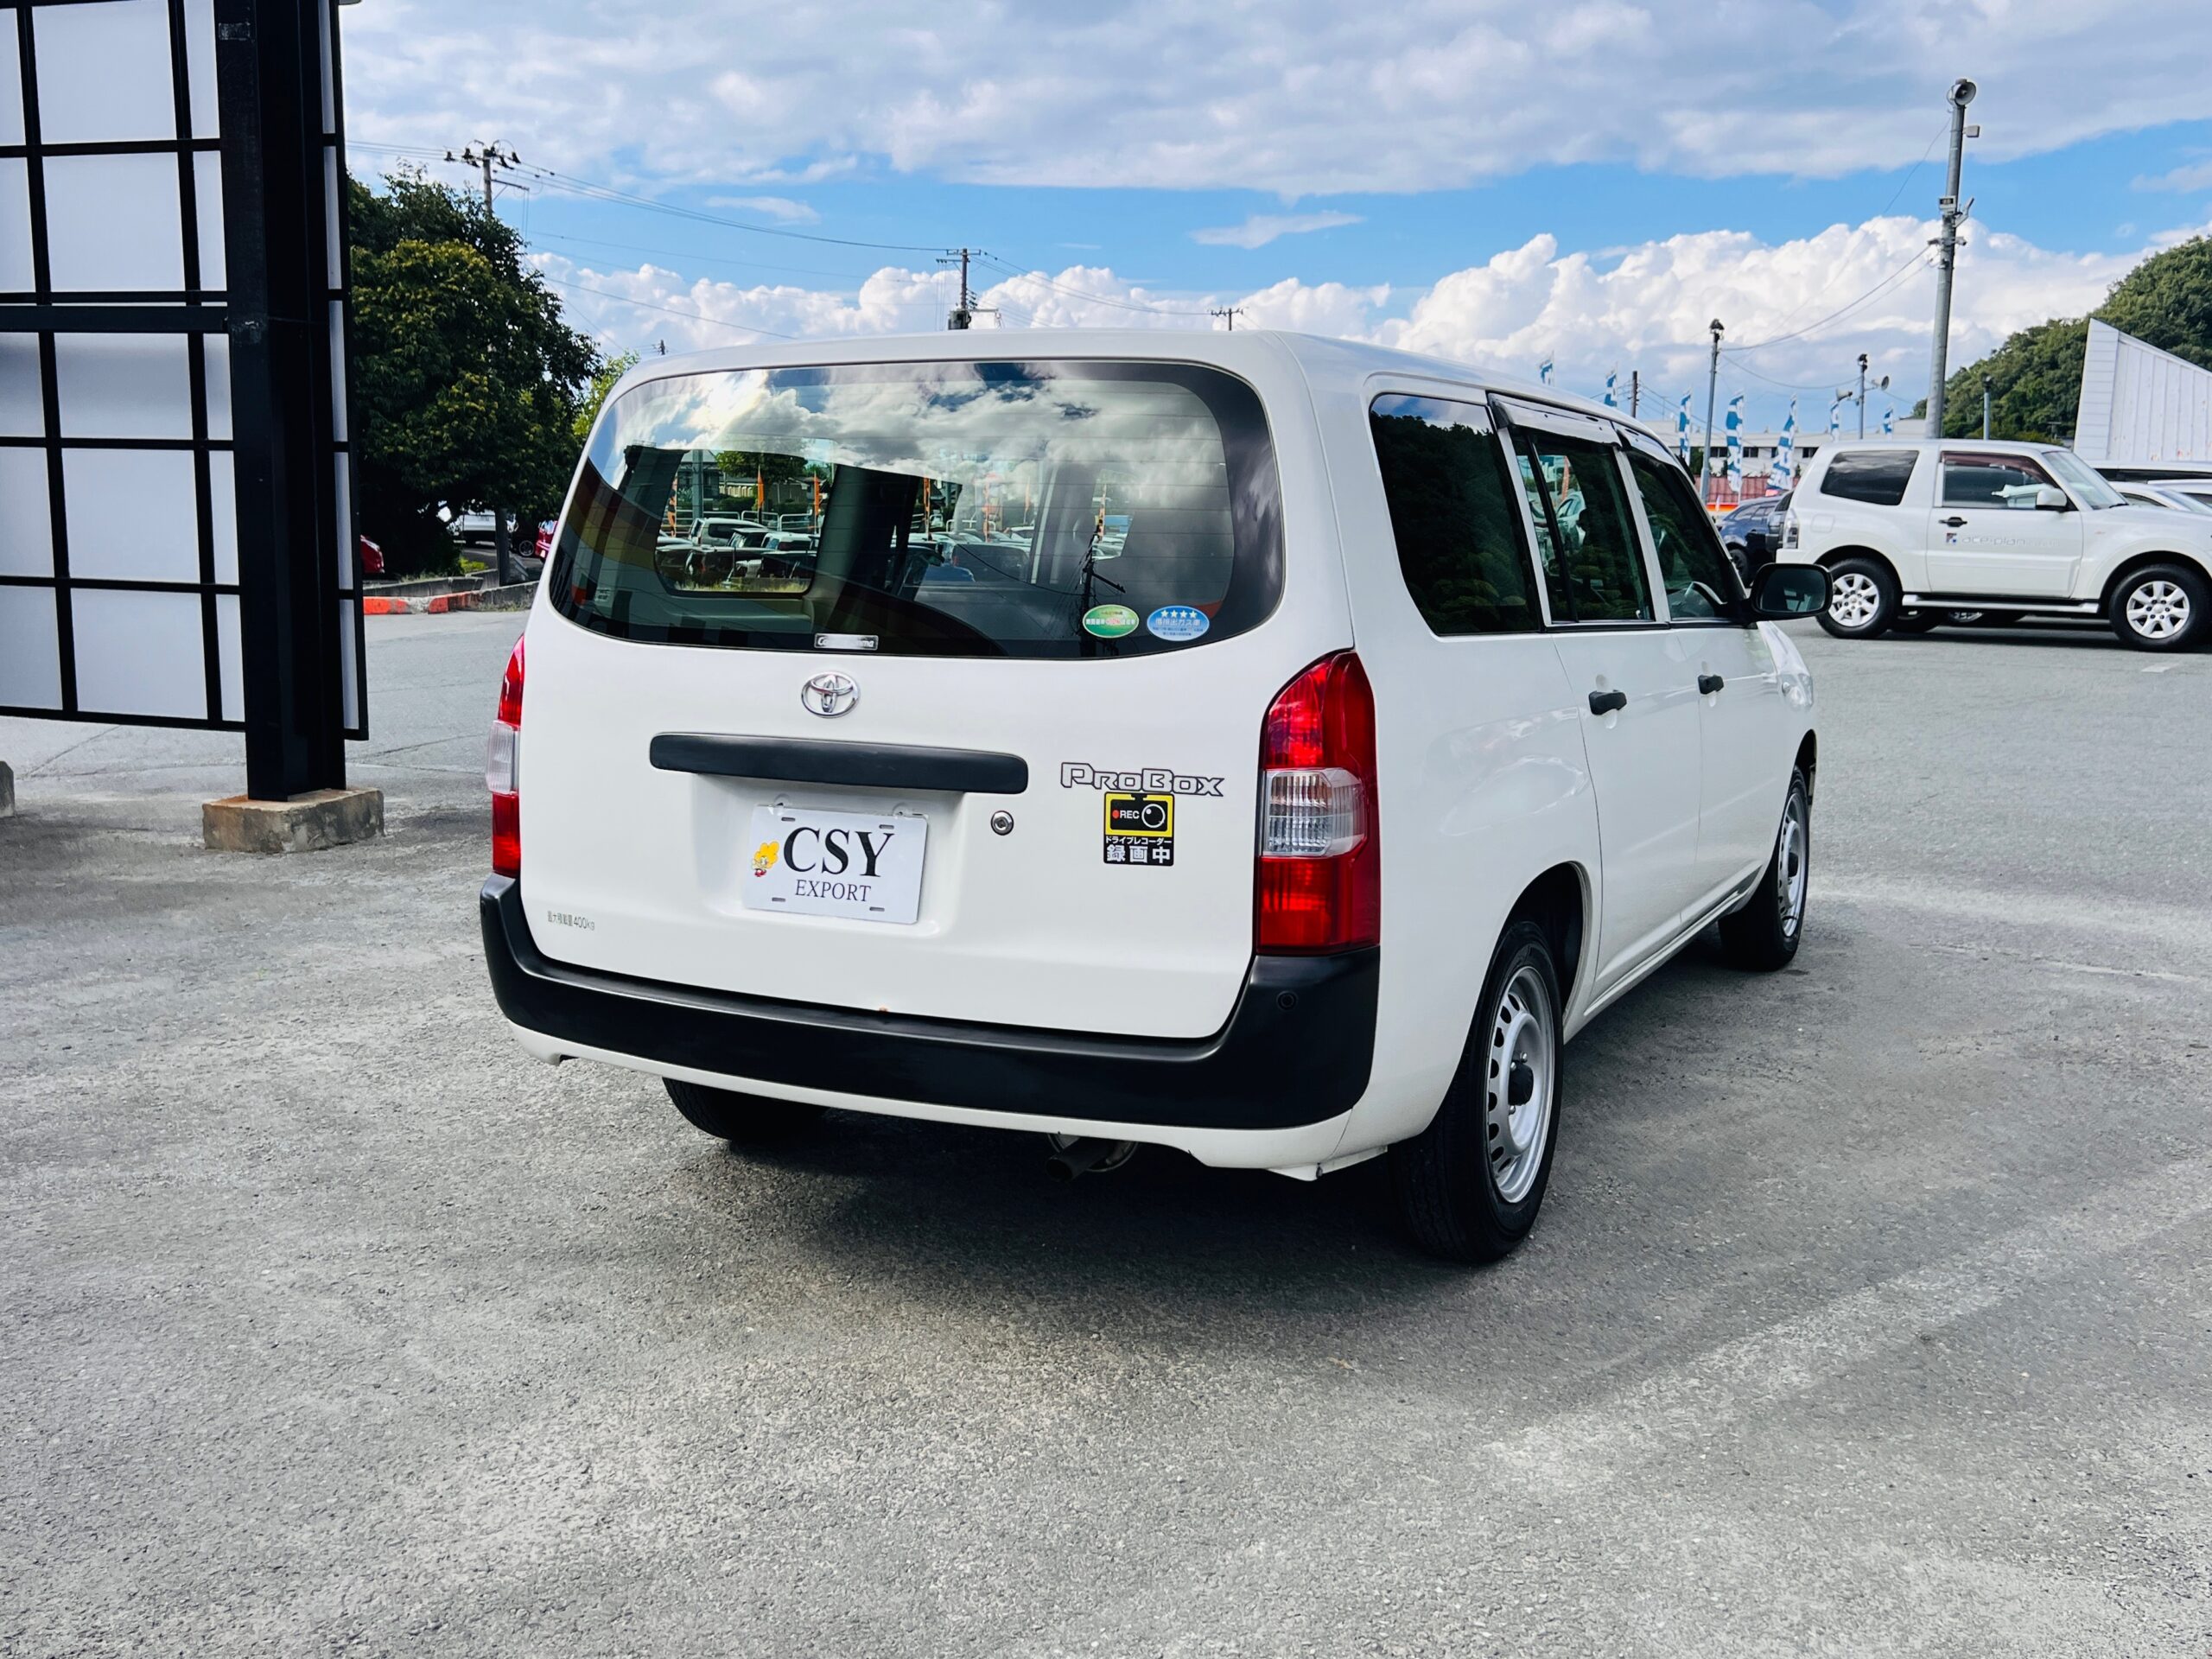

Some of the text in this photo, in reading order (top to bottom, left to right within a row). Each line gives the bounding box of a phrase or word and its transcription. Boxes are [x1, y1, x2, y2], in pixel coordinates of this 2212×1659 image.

[1060, 761, 1225, 798] ProBox
[1119, 810, 1140, 819] REC
[1105, 836, 1172, 846] ドライブレコーダー
[783, 826, 895, 878] CSY
[1106, 844, 1171, 864] 録画中
[795, 879, 872, 902] EXPORT
